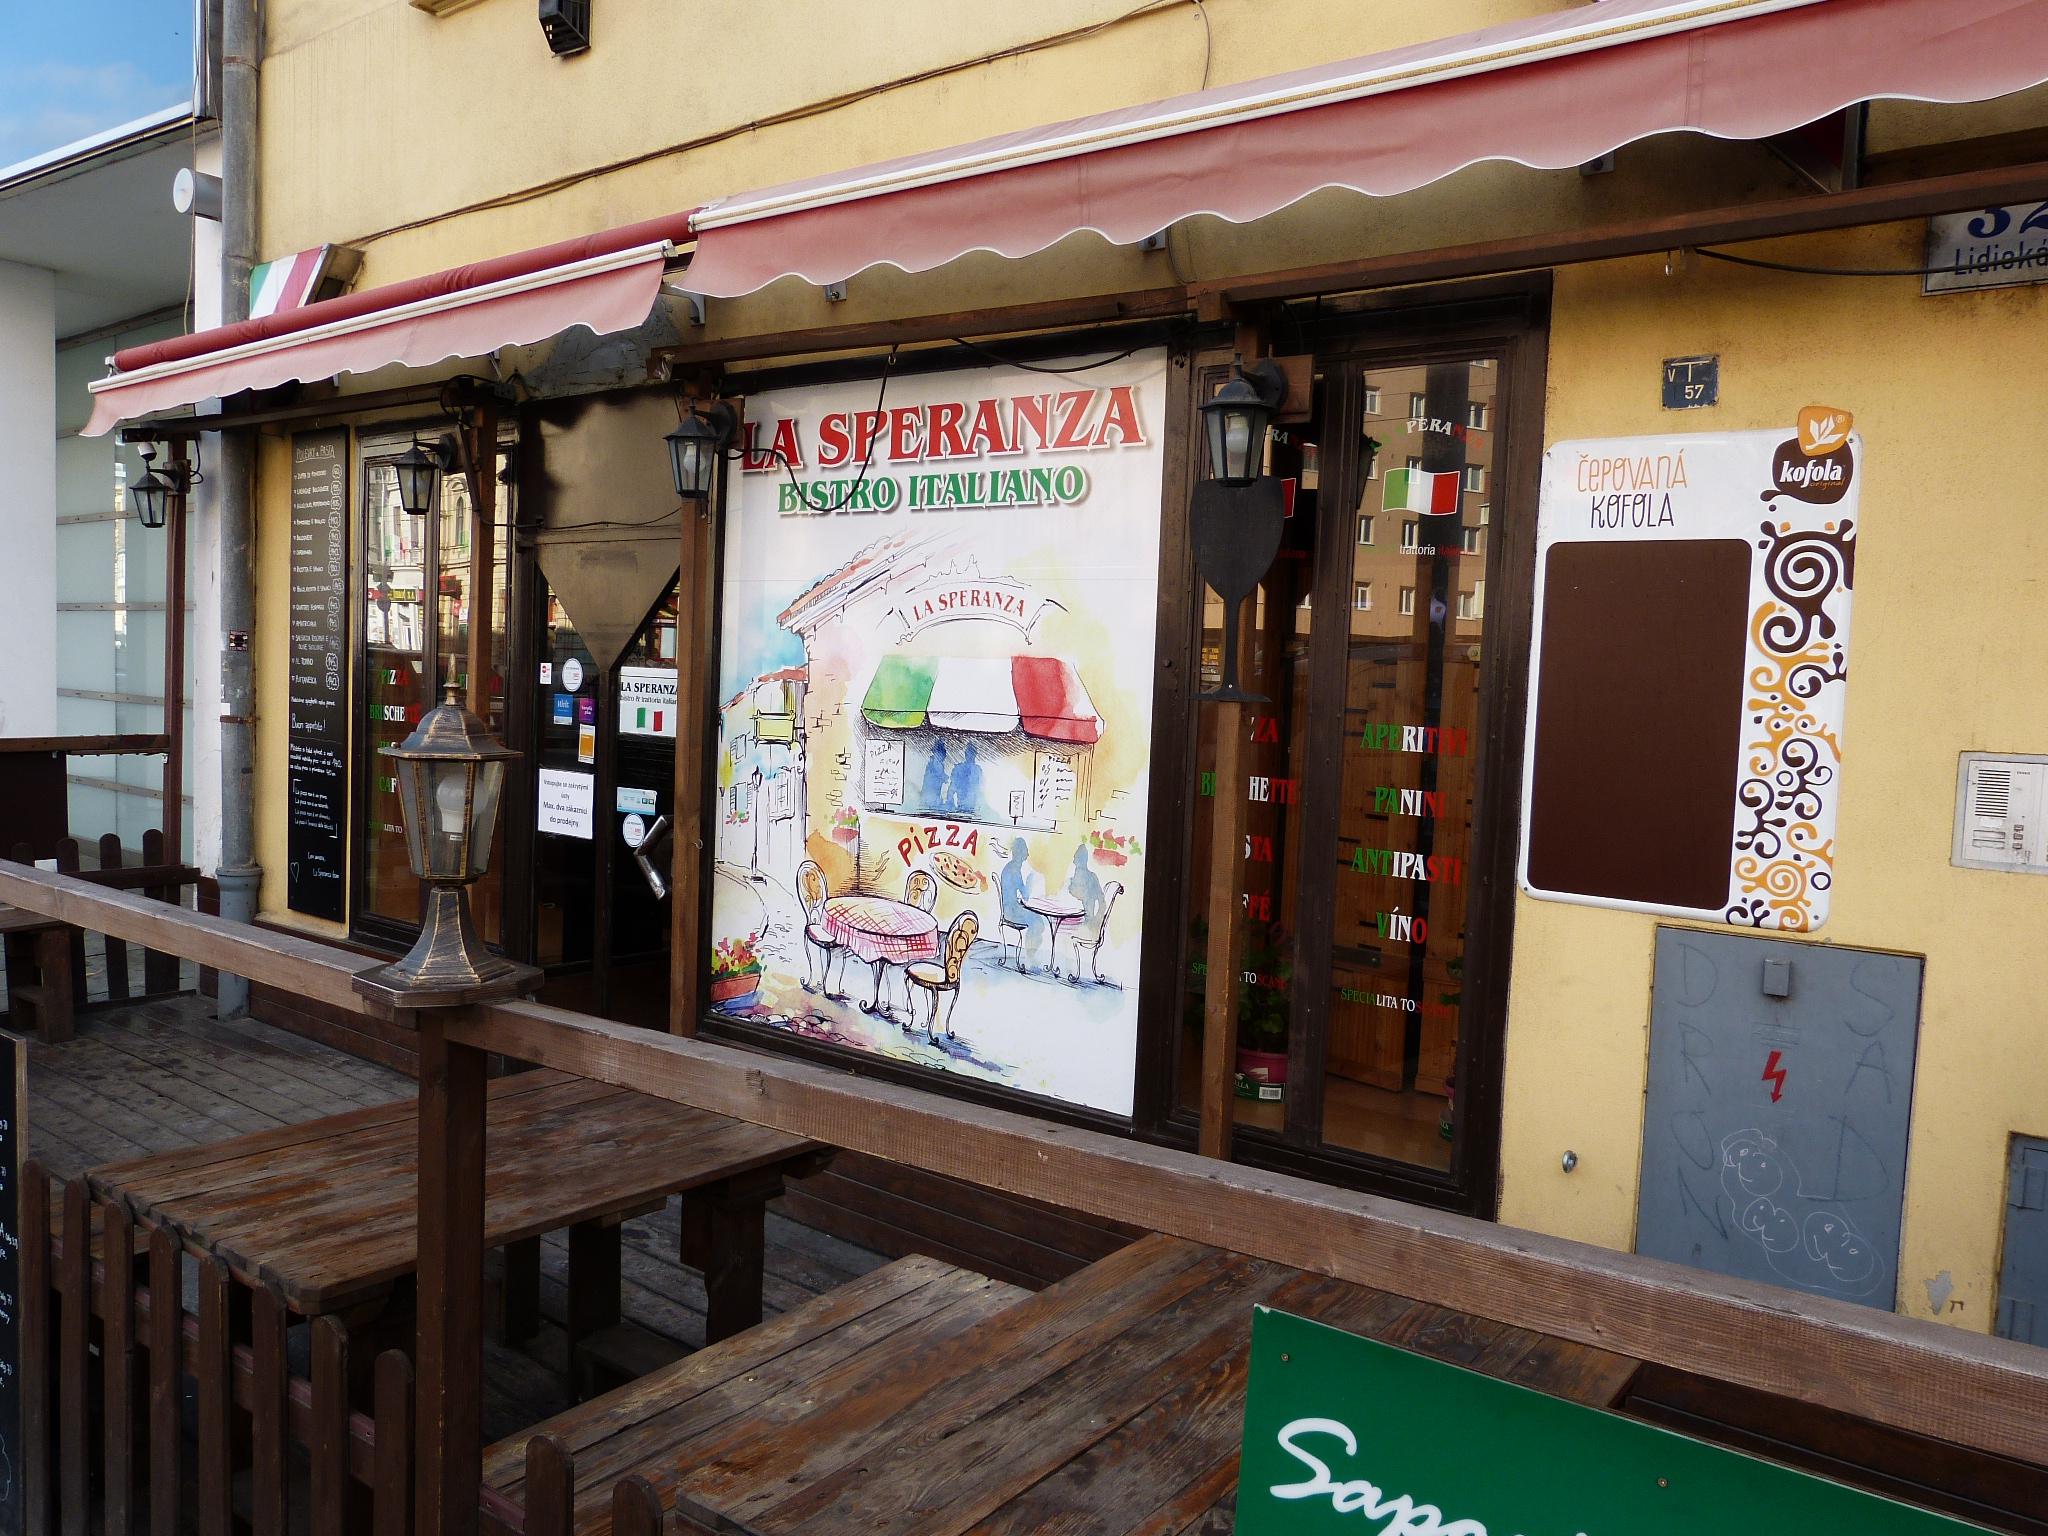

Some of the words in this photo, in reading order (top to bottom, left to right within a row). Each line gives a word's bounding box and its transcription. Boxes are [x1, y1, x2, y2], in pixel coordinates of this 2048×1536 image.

[1684, 384, 1705, 399] 57
[741, 418, 802, 472] LA
[817, 386, 1147, 467] SPERANZA
[778, 476, 897, 513] BISTRO
[908, 465, 1086, 508] ITALIANO
[1779, 458, 1842, 488] kofola
[1810, 478, 1845, 491] original
[1591, 493, 1675, 529] KOFOLA
[1400, 544, 1435, 556] trattoria
[913, 600, 934, 621] LA
[938, 590, 1025, 617] SPERANZA
[621, 682, 631, 692] LA
[1360, 723, 1468, 758] APERITIVI
[1374, 786, 1446, 818] PANINI
[898, 825, 980, 867] PIZZA
[1350, 847, 1462, 887] ANTIPASTI
[1376, 906, 1428, 945] VÍNO
